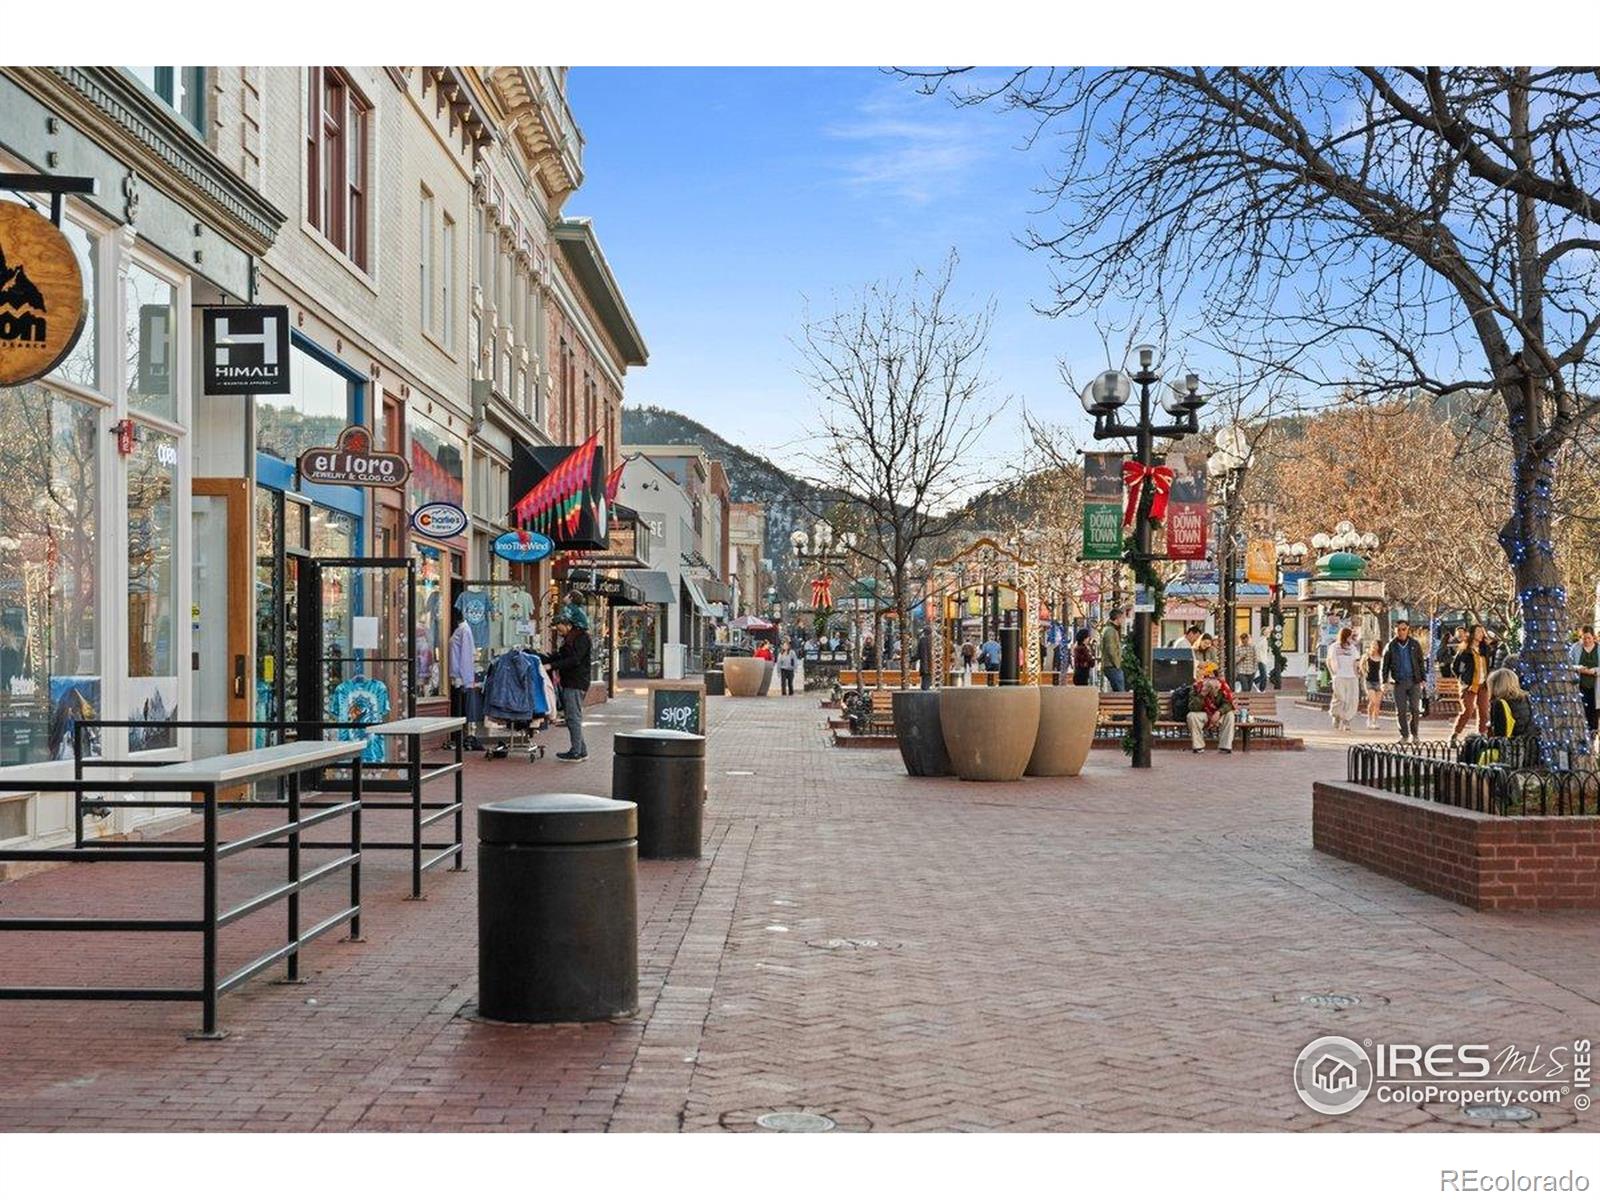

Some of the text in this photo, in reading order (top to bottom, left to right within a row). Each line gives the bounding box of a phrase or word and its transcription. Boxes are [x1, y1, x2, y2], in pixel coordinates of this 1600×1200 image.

[215, 366, 279, 377] HIMALI
[315, 455, 394, 475] el loro
[312, 471, 346, 480] JEWELRY
[1089, 514, 1118, 529] DOWN
[1172, 515, 1201, 529] DOWN
[1090, 529, 1118, 542] TOWN
[1173, 529, 1201, 543] TOWN
[660, 706, 692, 727] SHOP
